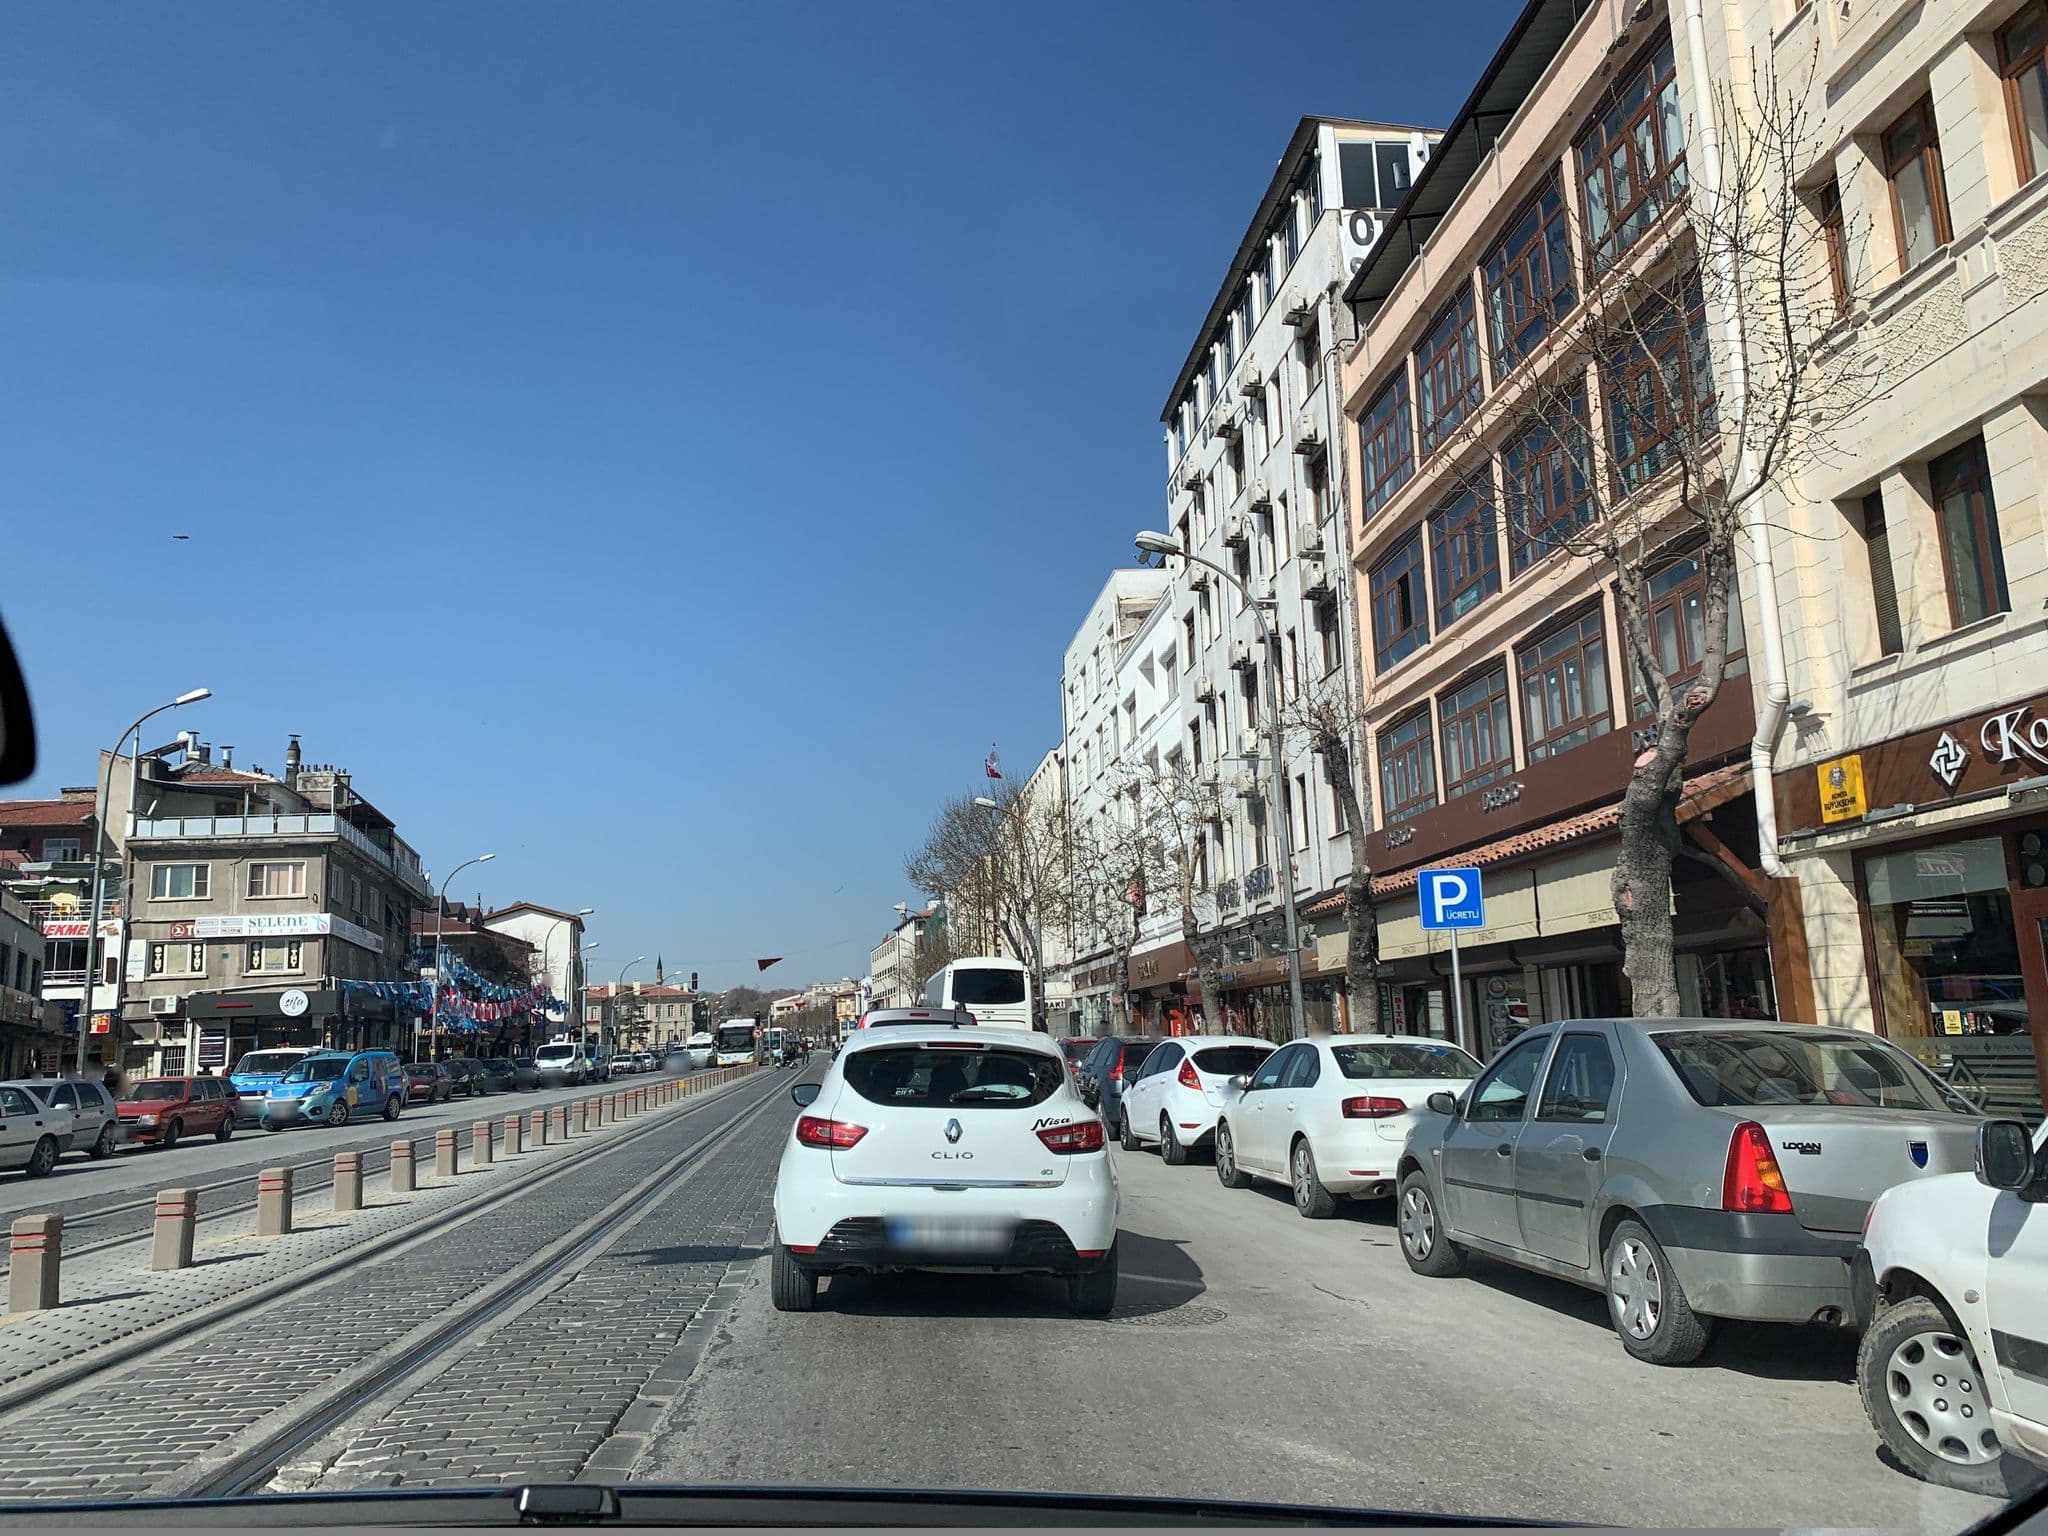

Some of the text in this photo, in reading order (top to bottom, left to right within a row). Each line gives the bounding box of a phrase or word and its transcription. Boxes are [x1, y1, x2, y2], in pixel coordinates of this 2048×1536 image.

[1432, 875, 1467, 923] P
[1588, 910, 1614, 924] DEFACTO
[1031, 1117, 1072, 1131] Nisa
[1783, 1142, 1821, 1151] LOGAN
[931, 1151, 974, 1160] CLIO
